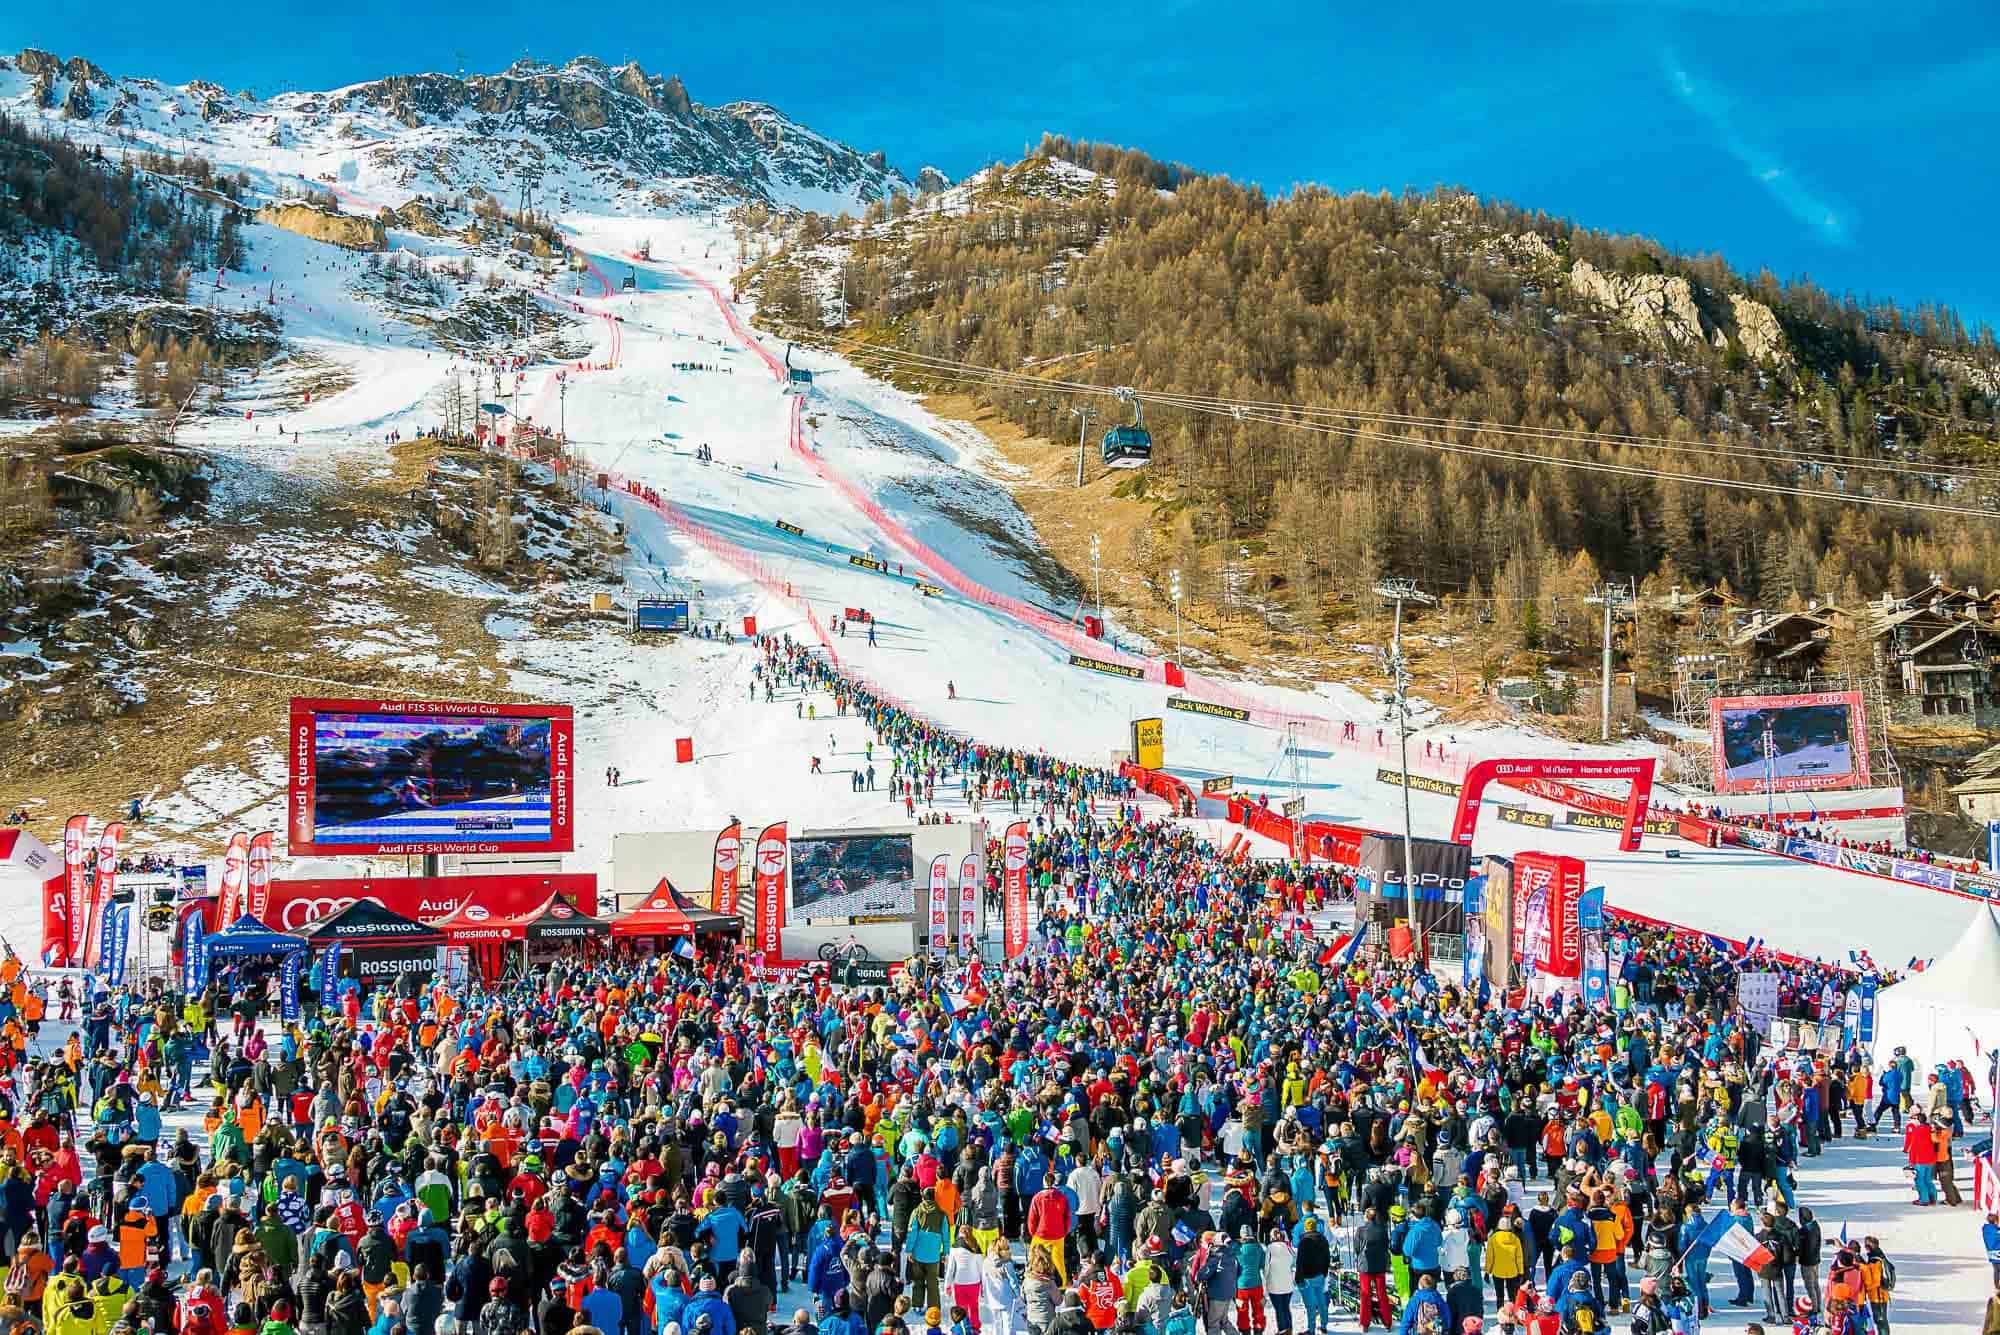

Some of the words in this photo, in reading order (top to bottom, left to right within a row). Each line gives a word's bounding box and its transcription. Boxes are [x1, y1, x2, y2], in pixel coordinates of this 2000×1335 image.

[1074, 657, 1093, 669] Jack
[1094, 661, 1130, 676] Wolfskin
[380, 702, 405, 712] Audi
[408, 703, 425, 713] FIS
[427, 704, 443, 713] Ski
[444, 704, 480, 714] World
[481, 706, 499, 714] Cup
[1173, 699, 1194, 711] Jack
[1195, 703, 1233, 718] Wolfskin
[1140, 727, 1155, 737] Jack
[298, 726, 310, 786] quattro
[556, 731, 568, 769] Audi
[1408, 776, 1452, 795] Wolfskin
[1787, 777, 1837, 791] quattro
[556, 770, 568, 826] quattro
[296, 793, 307, 826] Audi
[1574, 813, 1601, 828] Jack
[378, 844, 405, 854] Audi
[407, 844, 425, 853] FIS
[427, 843, 443, 853] Ski
[444, 843, 480, 853] World
[481, 844, 499, 853] Cup
[1384, 870, 1465, 889] GoPro
[418, 898, 458, 912] Audi
[766, 877, 777, 952] ROSSIGNOL
[1010, 871, 1022, 946] ROSSIGNOL
[1563, 872, 1581, 961] GENERALI
[103, 909, 112, 959] ALPINA
[335, 923, 422, 934] ROSSIGNOL
[453, 929, 500, 939] ROSSIGNOL
[540, 928, 586, 937] ROSSIGNOL
[327, 947, 336, 984] ALPINA
